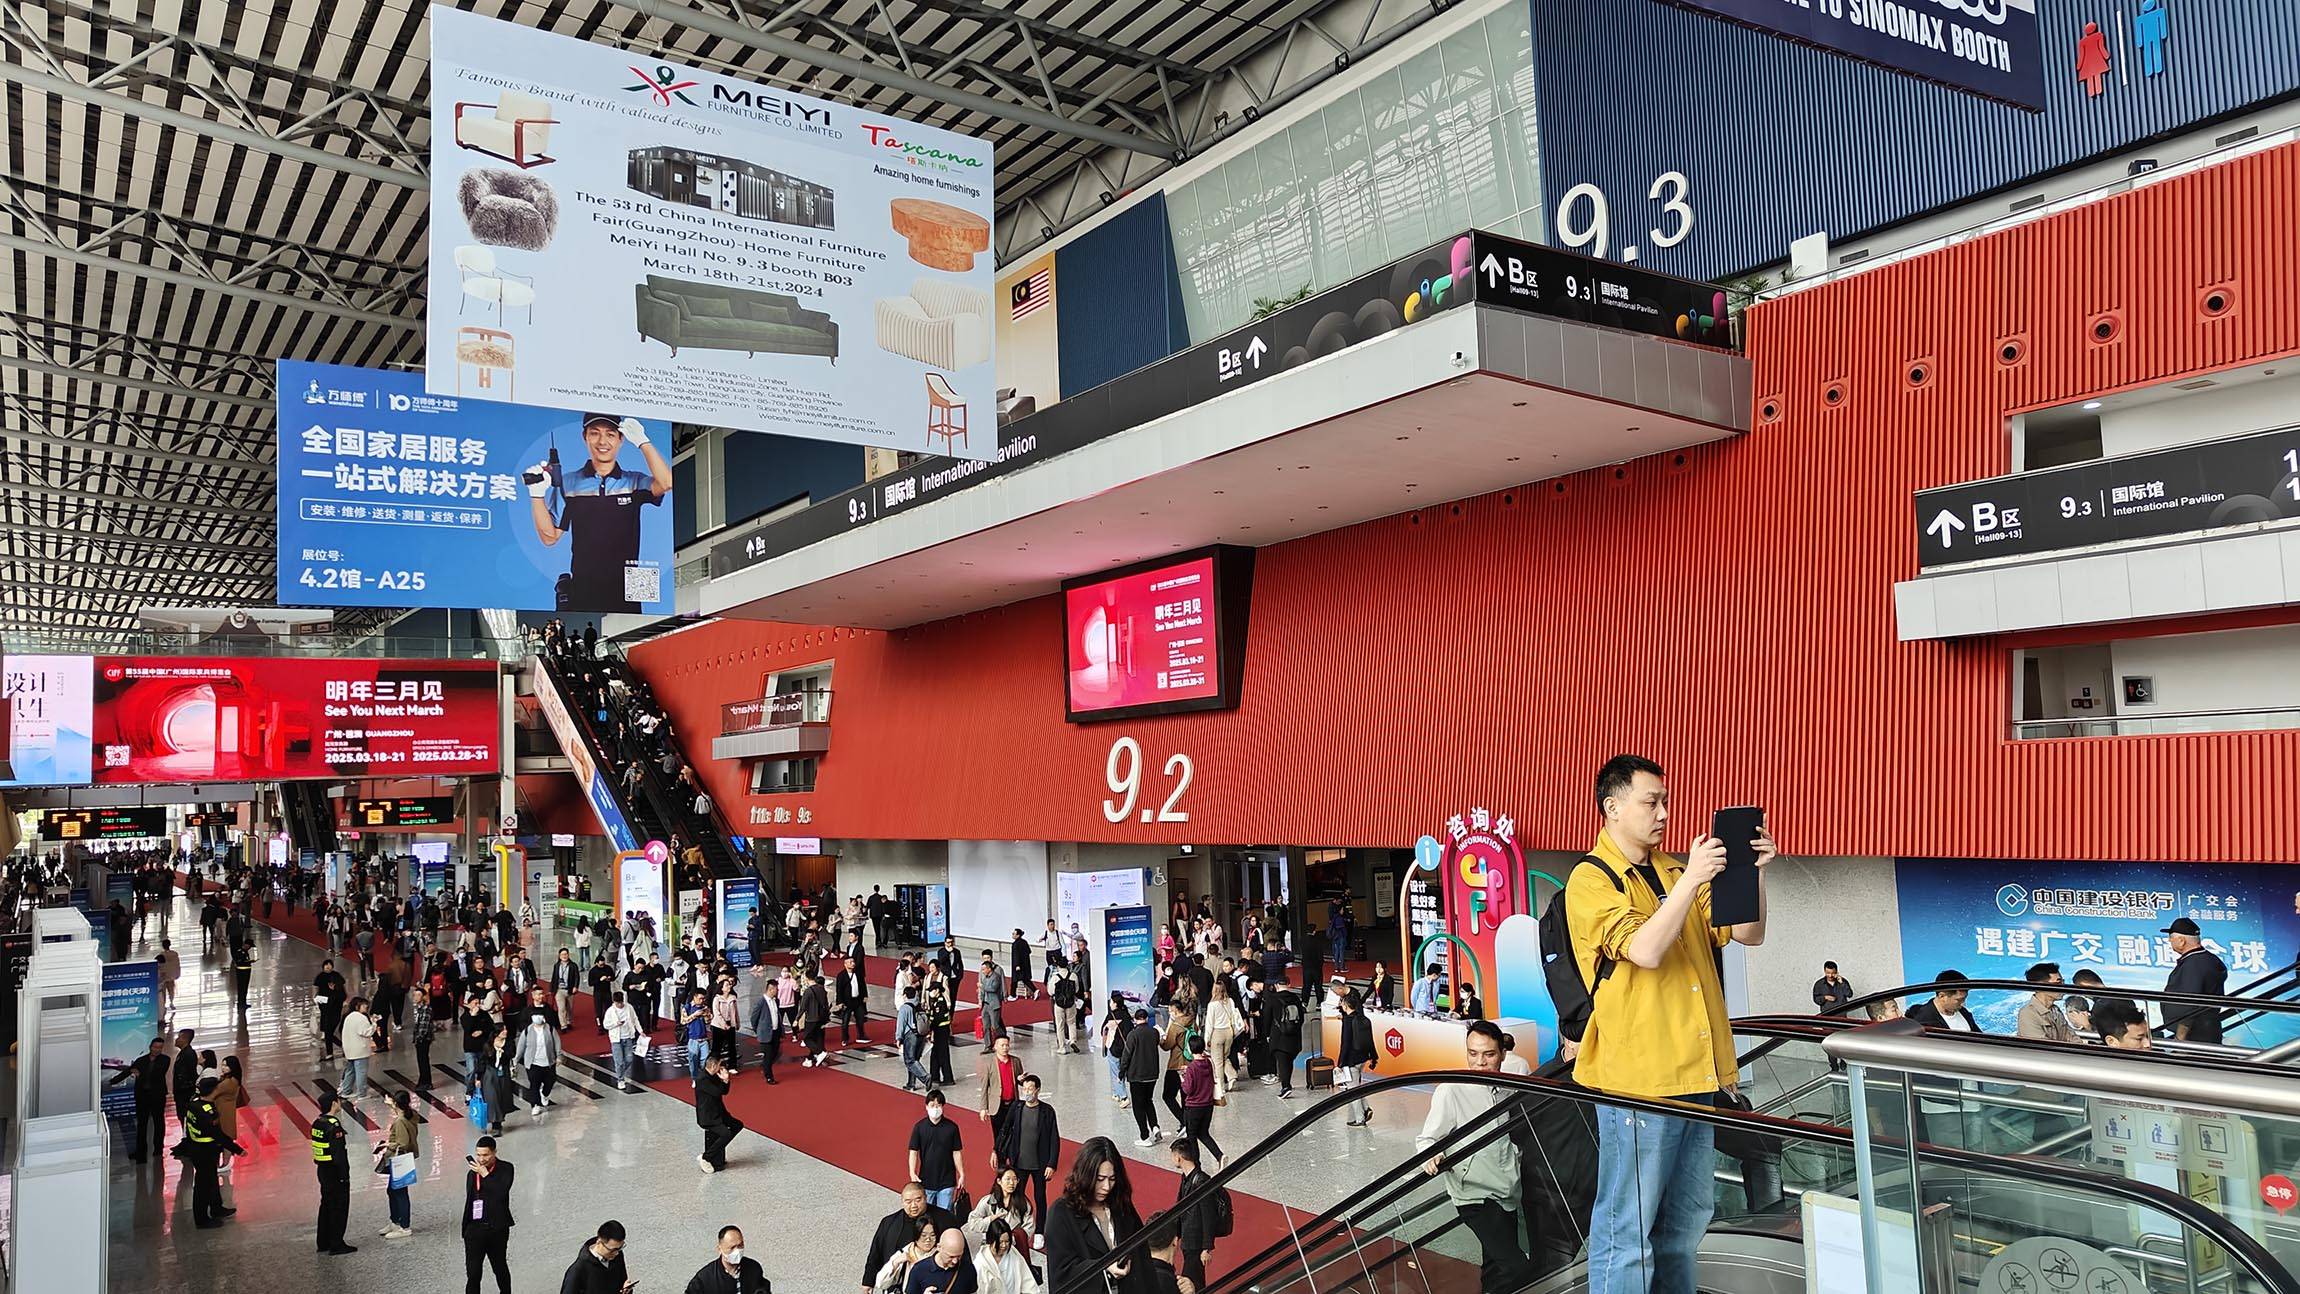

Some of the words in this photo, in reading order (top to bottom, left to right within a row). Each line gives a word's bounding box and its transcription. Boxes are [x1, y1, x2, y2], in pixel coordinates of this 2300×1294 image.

[1850, 0, 1946, 52] SINOMAX
[1951, 23, 2011, 72] BOOTH
[455, 68, 522, 91] Famous
[527, 84, 577, 103] Brand
[581, 97, 616, 113] with
[621, 106, 667, 125] valued
[671, 114, 723, 137] designs
[708, 102, 771, 124] FURNITURE
[713, 84, 830, 126] MEIYI
[861, 124, 983, 168] Tascana
[873, 163, 909, 183] Amazing
[911, 173, 934, 188] home
[935, 178, 980, 198] furnishings
[575, 191, 606, 207] The
[613, 200, 631, 211] 53
[635, 202, 651, 215] rd
[659, 207, 706, 225] China
[712, 217, 813, 246] International
[819, 239, 886, 261] Furniture
[1557, 171, 1694, 264] 9.3
[610, 233, 659, 250] MeiYi
[665, 243, 697, 258] Hall
[703, 250, 731, 265] No.
[771, 261, 817, 281] booth
[823, 272, 853, 287] B03
[643, 256, 696, 276] March
[797, 251, 866, 273] Furniture
[1508, 257, 1539, 287] B区
[1566, 276, 1591, 301] 9.3
[1601, 282, 1629, 300] 国际馆
[1602, 297, 1636, 311] International
[1637, 304, 1659, 316] Pavilion
[1218, 348, 1242, 374] B区
[301, 425, 488, 466] 全国家居服务
[989, 434, 1037, 466] avilion
[301, 463, 517, 501] 一站式解决方案
[885, 476, 916, 509] 国际馆
[2111, 480, 2165, 504] 国际馆
[848, 498, 867, 523] 9.3
[2060, 496, 2092, 519] 9.3
[2113, 495, 2180, 516] International
[2180, 491, 2225, 506] Pavilion
[1972, 501, 2021, 533] B区
[1975, 529, 2022, 545] [Hall09-13]
[6, 672, 46, 694] 设计
[325, 681, 444, 701] 明年三月见
[325, 706, 348, 716] See
[349, 705, 373, 716] You
[375, 705, 405, 716] Next
[407, 704, 444, 716] March
[365, 730, 414, 738] GUANGZHOU
[325, 752, 405, 764] 2025.03.18-21
[412, 750, 489, 762] 2025.03.28-31
[1103, 736, 1195, 824] 9.2
[1447, 806, 1515, 844] 咨询处
[1458, 835, 1502, 854] INFORMATION
[2033, 889, 2174, 911] 中国建设银行
[2034, 904, 2062, 915] China
[2064, 905, 2126, 918] Construction
[2127, 908, 2158, 920] Bank
[2187, 895, 2239, 908] 广交会
[2188, 909, 2239, 921] 金融服务
[1976, 927, 2105, 965] 遇建广交
[2266, 1185, 2292, 1200] 急停
